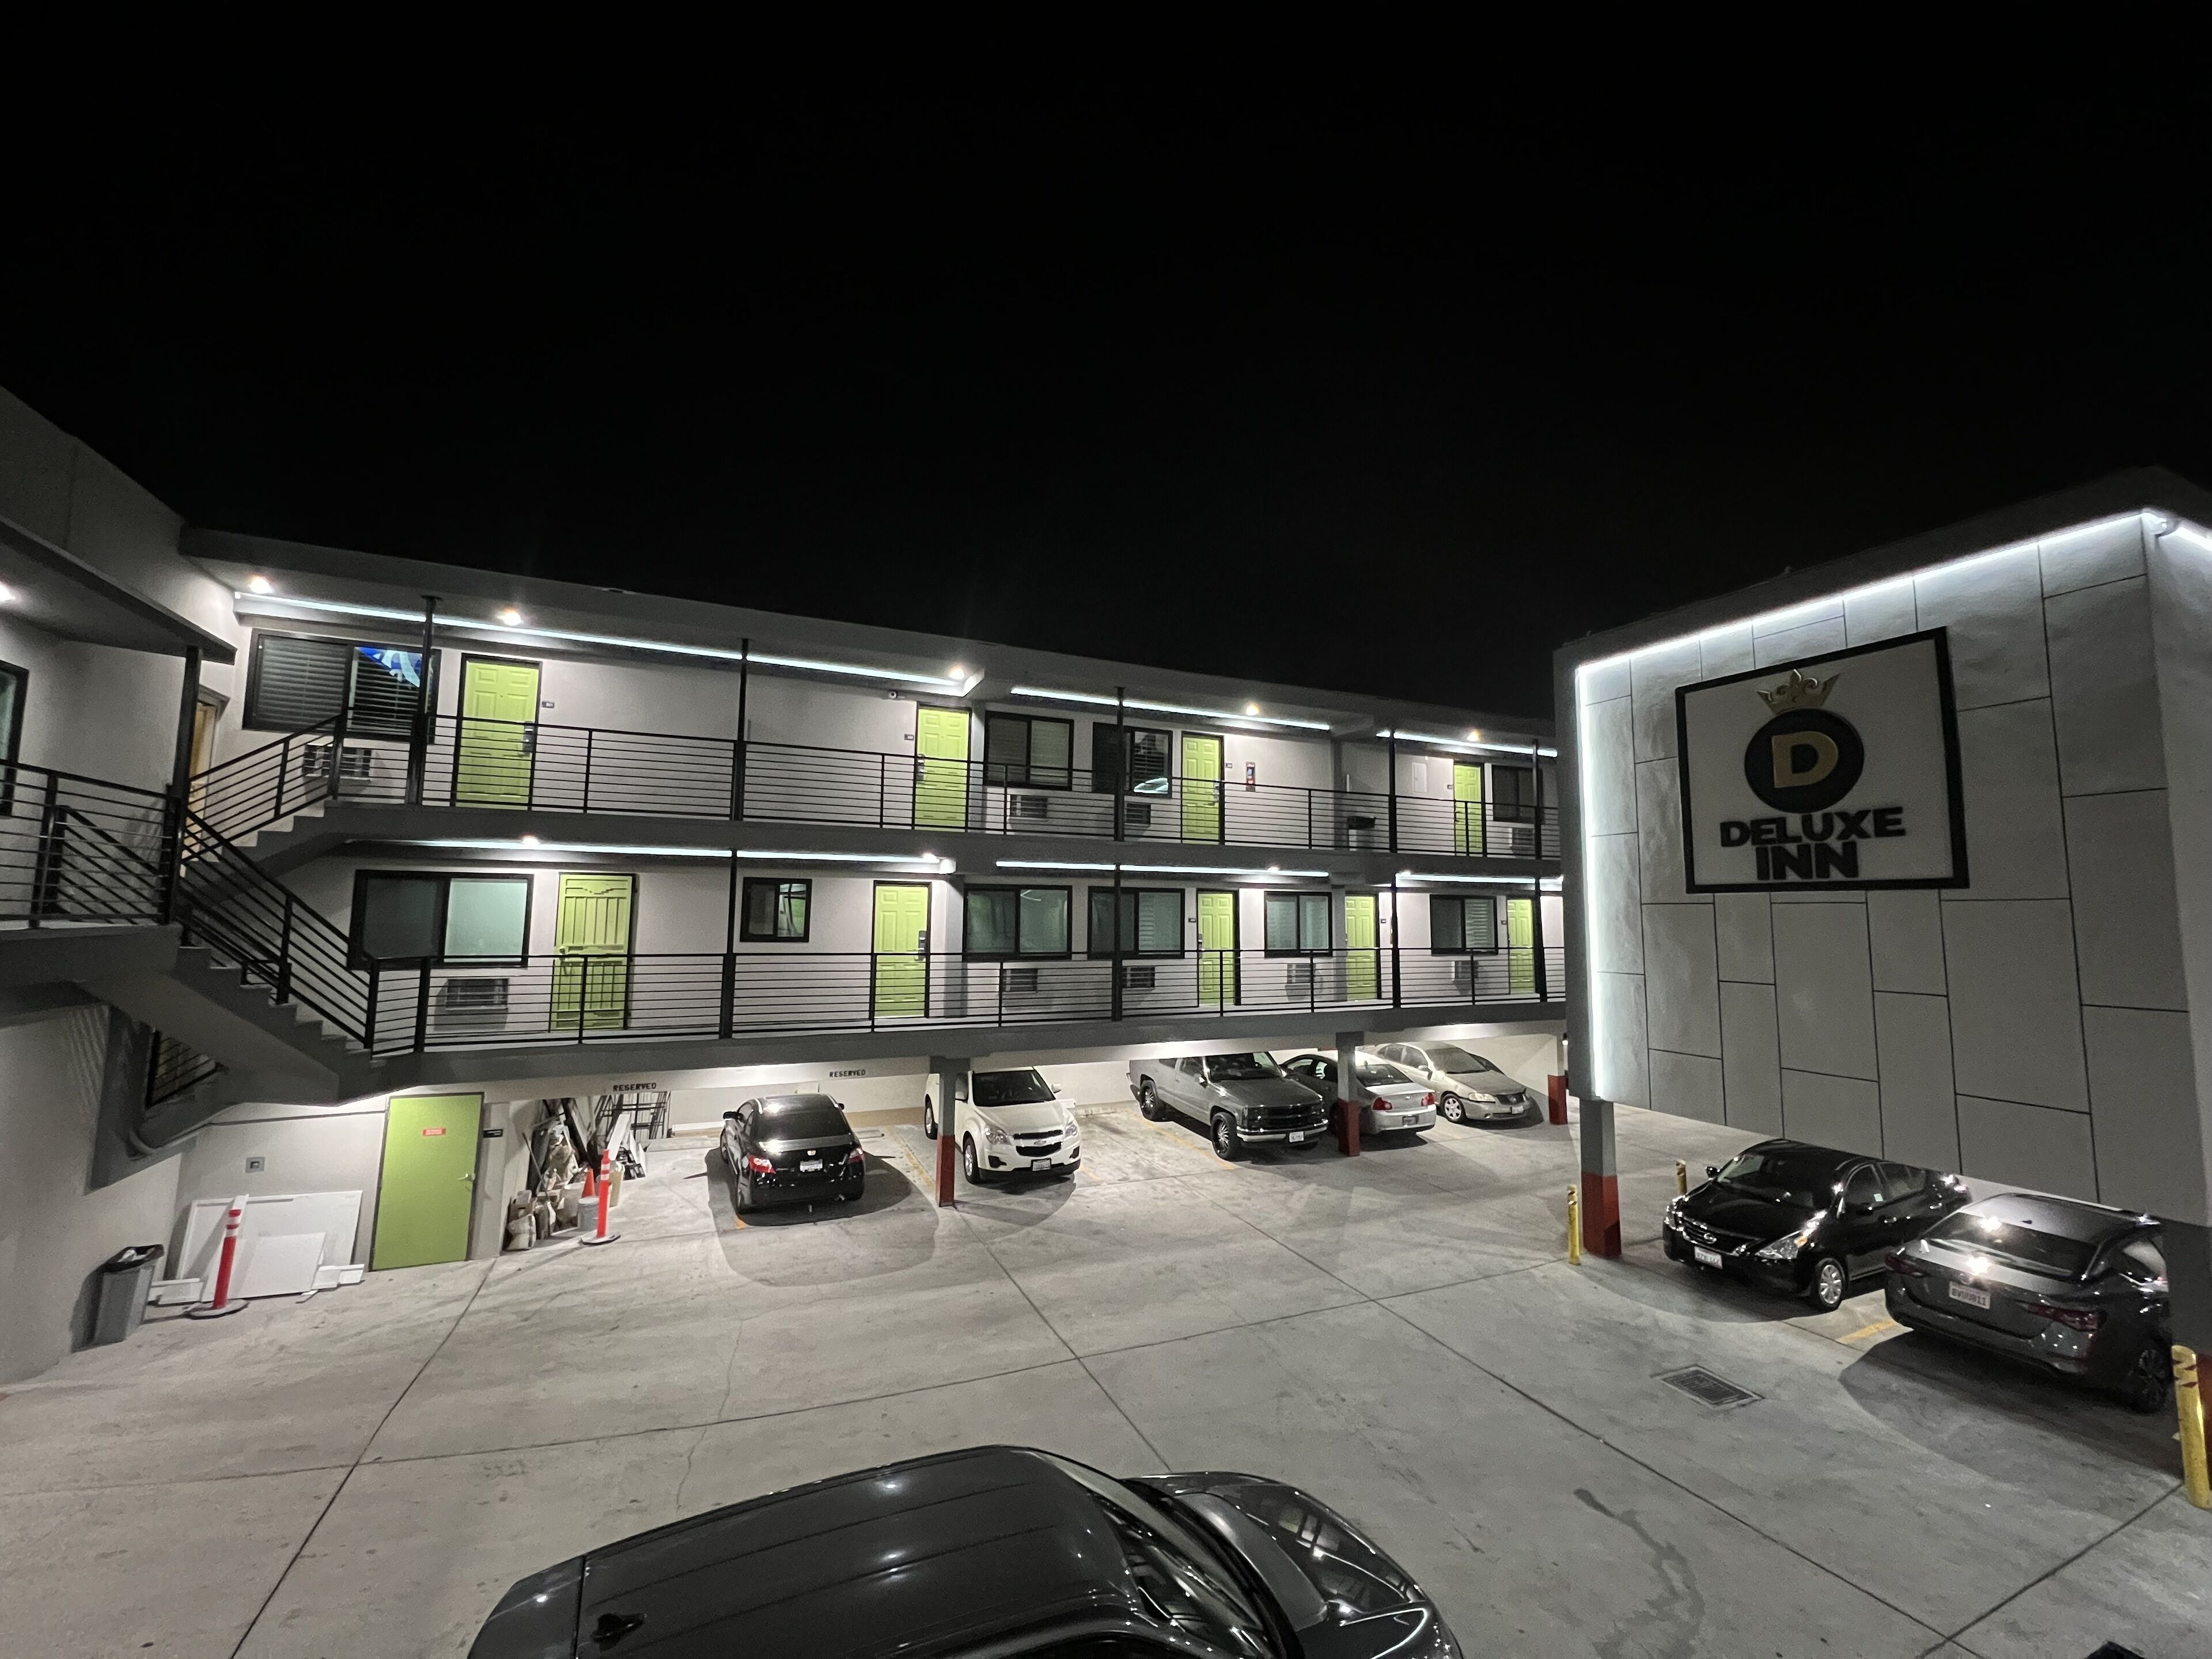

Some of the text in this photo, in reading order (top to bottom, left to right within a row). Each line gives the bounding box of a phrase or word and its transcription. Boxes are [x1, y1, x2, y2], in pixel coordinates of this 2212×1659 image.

[1772, 731, 1838, 788] D
[1720, 807, 1906, 847] DELUXE
[1755, 841, 1859, 880] INN
[613, 1083, 657, 1092] RESERVED
[829, 1069, 866, 1078] RESERVED
